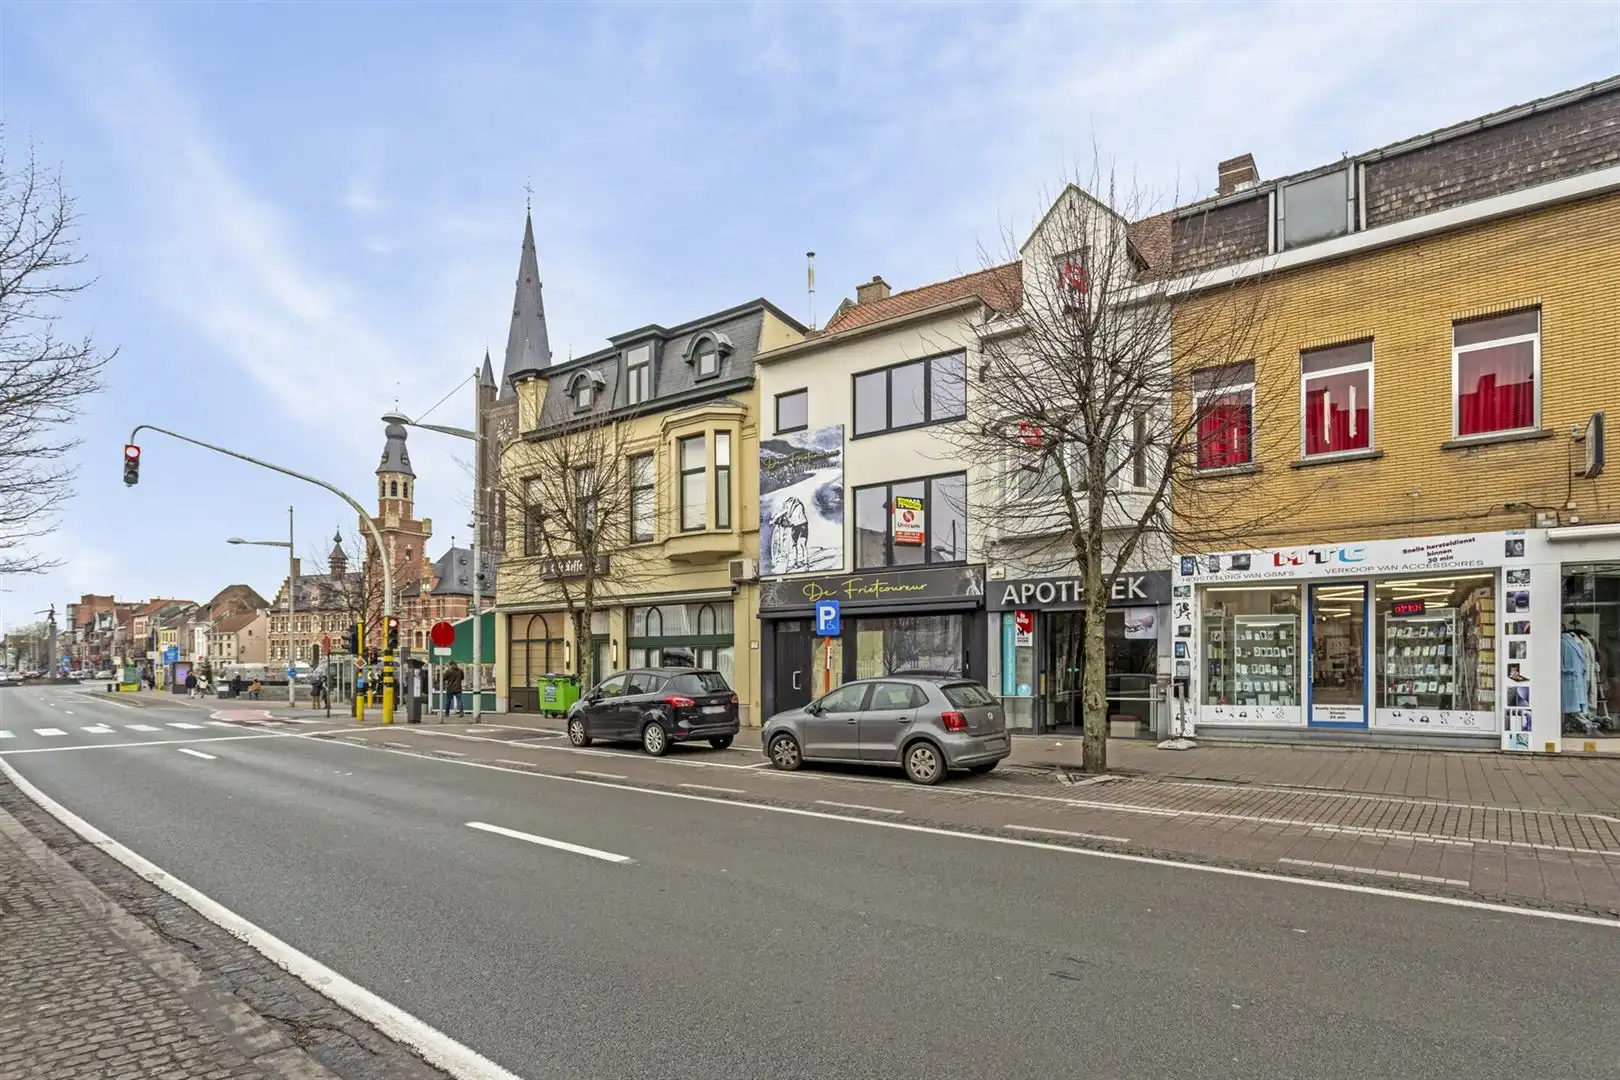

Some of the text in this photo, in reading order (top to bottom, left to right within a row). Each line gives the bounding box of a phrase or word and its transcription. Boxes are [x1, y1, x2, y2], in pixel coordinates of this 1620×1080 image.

[897, 521, 921, 529] Unicum
[1402, 546, 1425, 555] Snelle
[1427, 548, 1452, 557] binnen
[1439, 554, 1454, 562] min
[1324, 559, 1484, 574] VERKOOP VAN ACCESSOIRES
[1243, 571, 1262, 579] VAN
[802, 581, 838, 602] De
[1001, 576, 1148, 605] APOTHEK
[1394, 603, 1422, 613] OPEN
[819, 606, 836, 630] P
